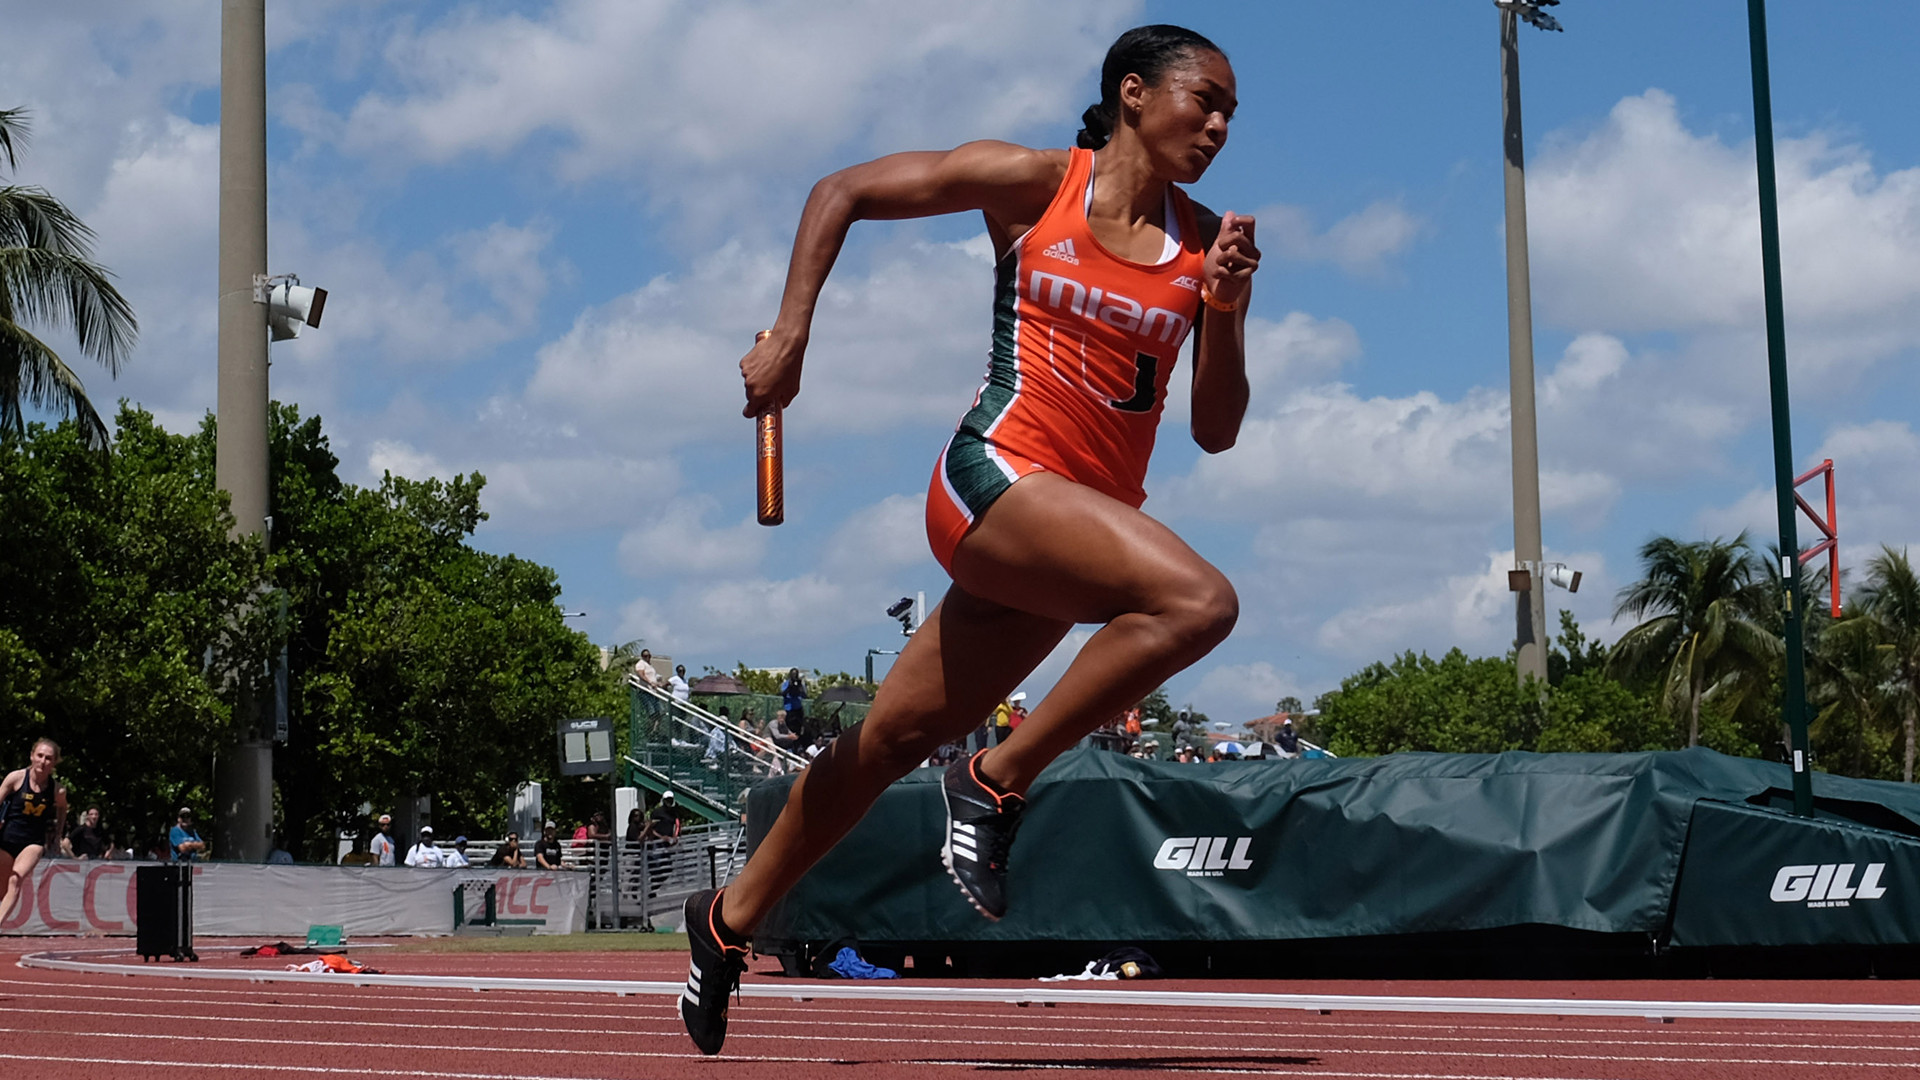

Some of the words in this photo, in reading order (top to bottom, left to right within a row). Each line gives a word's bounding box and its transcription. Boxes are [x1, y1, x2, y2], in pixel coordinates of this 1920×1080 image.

[1042, 248, 1080, 266] adidas
[1169, 275, 1199, 291] ACC
[22, 801, 46, 817] M
[1153, 837, 1254, 870] GILL
[1769, 863, 1887, 902] GILL
[477, 876, 554, 915] ACC
